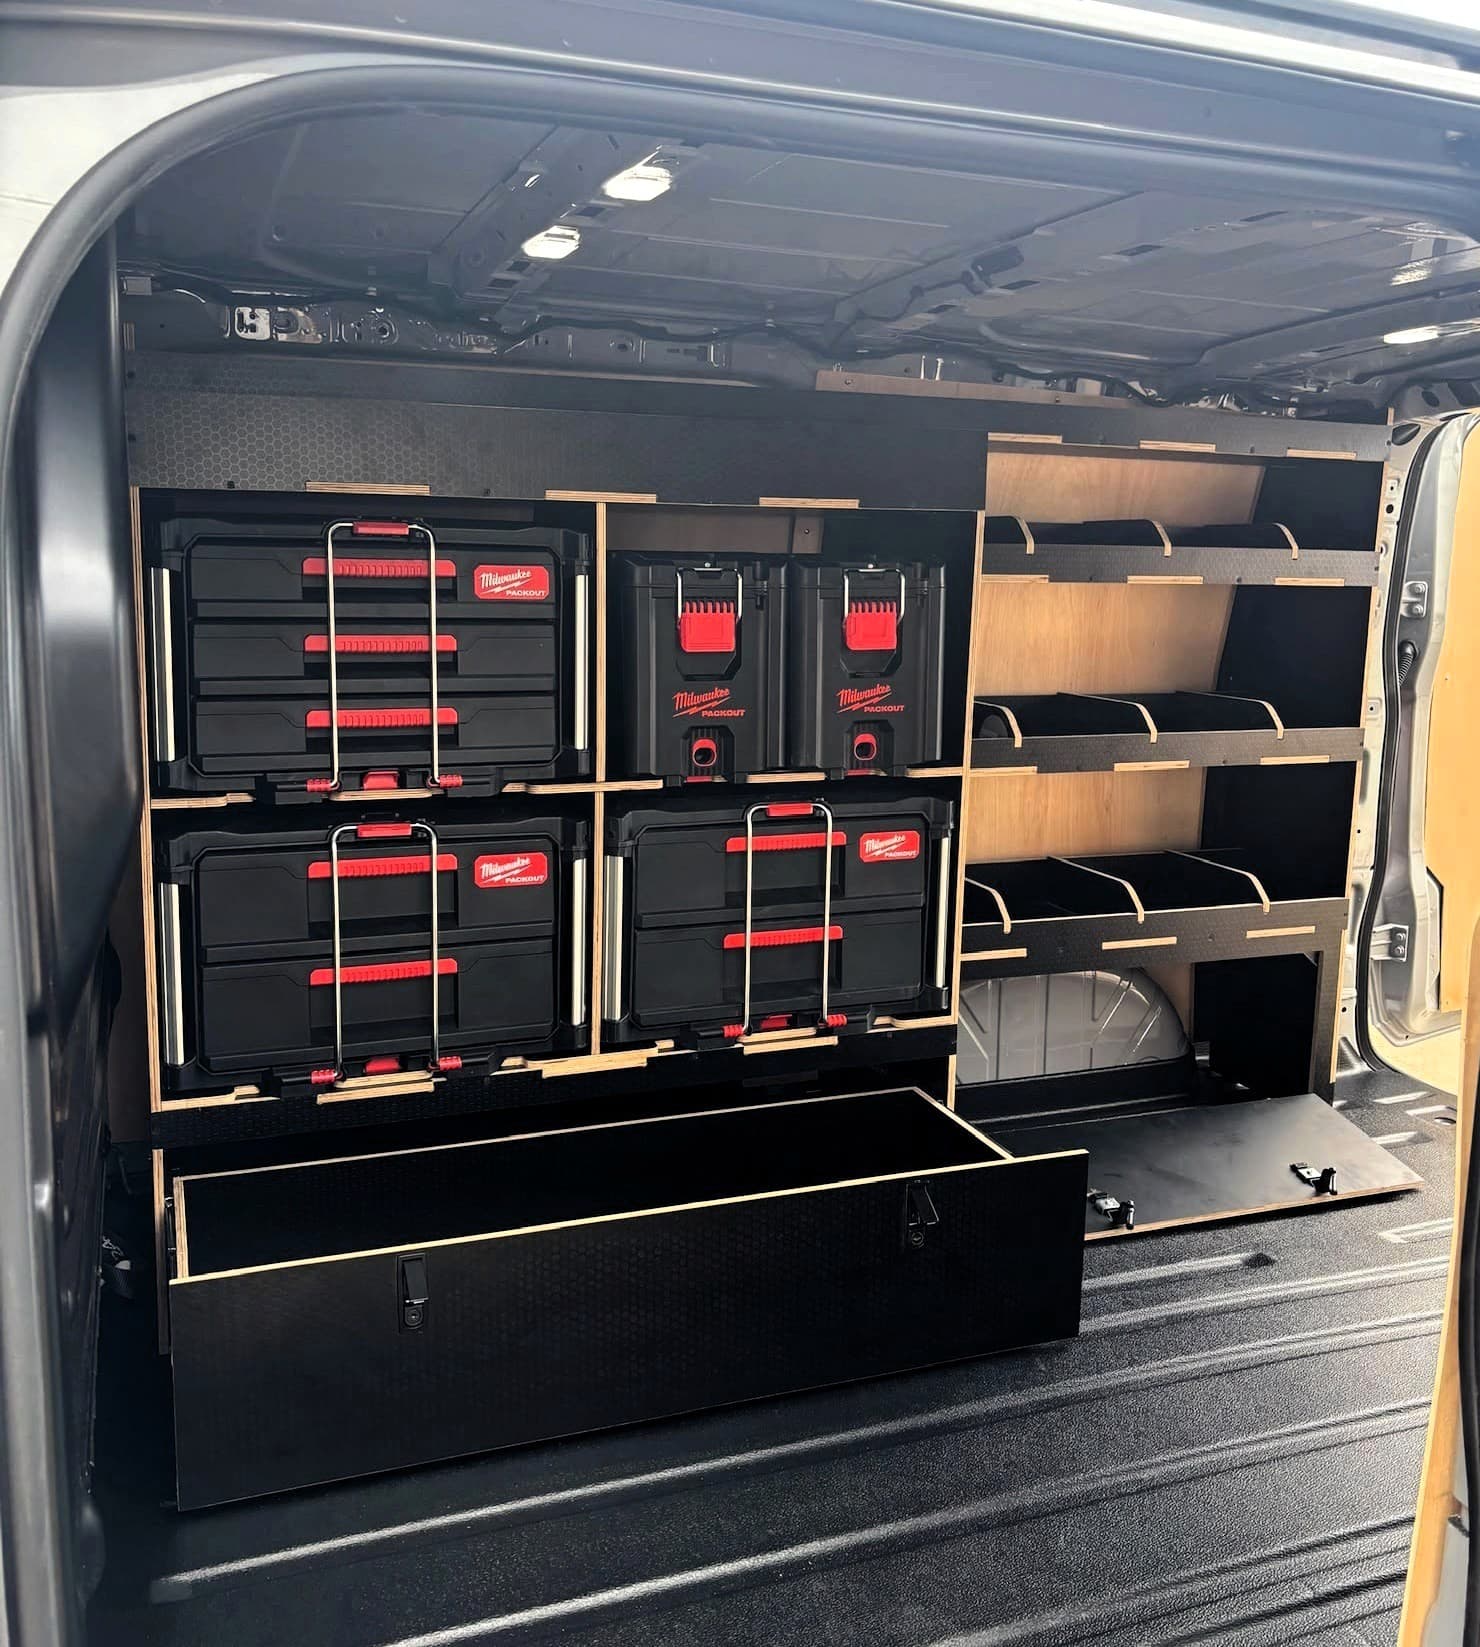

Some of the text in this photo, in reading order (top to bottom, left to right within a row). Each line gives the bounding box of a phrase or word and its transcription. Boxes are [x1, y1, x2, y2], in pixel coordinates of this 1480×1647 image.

[480, 568, 532, 589] Milwaukee
[672, 687, 730, 711] Milwaukee
[836, 683, 892, 707] Milwaukee
[701, 709, 746, 717] PACKOUT
[864, 705, 905, 713] PACKOUT
[480, 857, 531, 879] Milwaukee
[505, 875, 545, 883] PACKOUT
